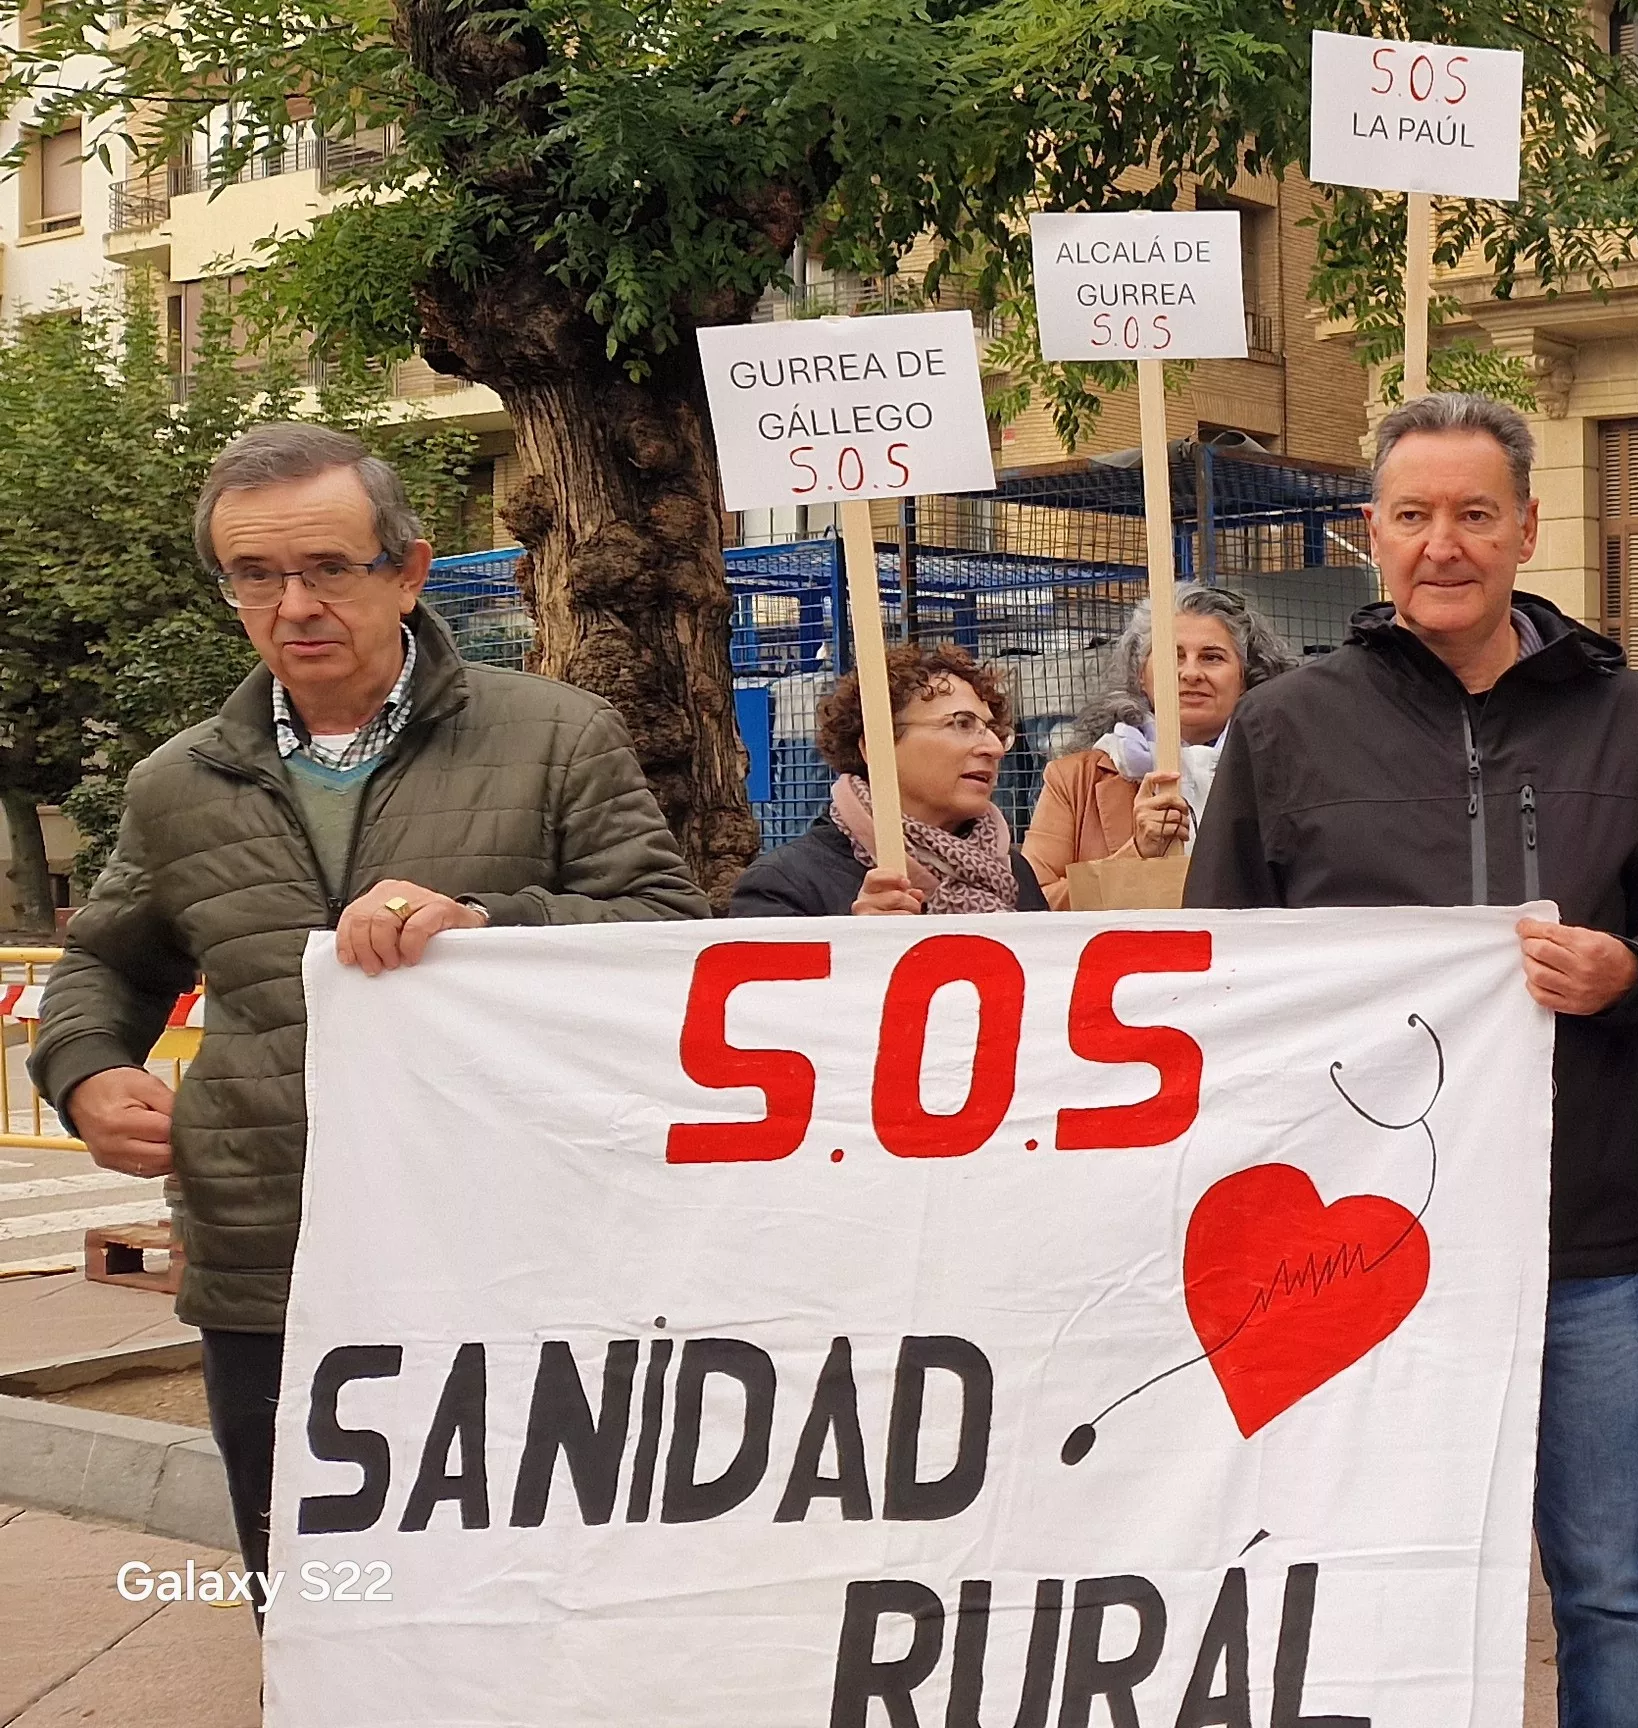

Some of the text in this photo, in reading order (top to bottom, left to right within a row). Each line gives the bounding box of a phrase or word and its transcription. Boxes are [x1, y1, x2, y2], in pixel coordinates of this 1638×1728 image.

[1372, 47, 1470, 106] S.O.S
[1353, 112, 1475, 148] LA PAÚL
[1056, 234, 1211, 264] ALCALÁ DE
[1077, 283, 1196, 307] GURREA
[1090, 314, 1172, 350] S.O.S
[730, 348, 946, 390] GURREA DE
[757, 402, 933, 442] GÁLLEGO
[789, 443, 911, 495] S.O.S
[666, 929, 1213, 1165] S.O.S
[829, 1529, 1371, 1728] RURÁL
